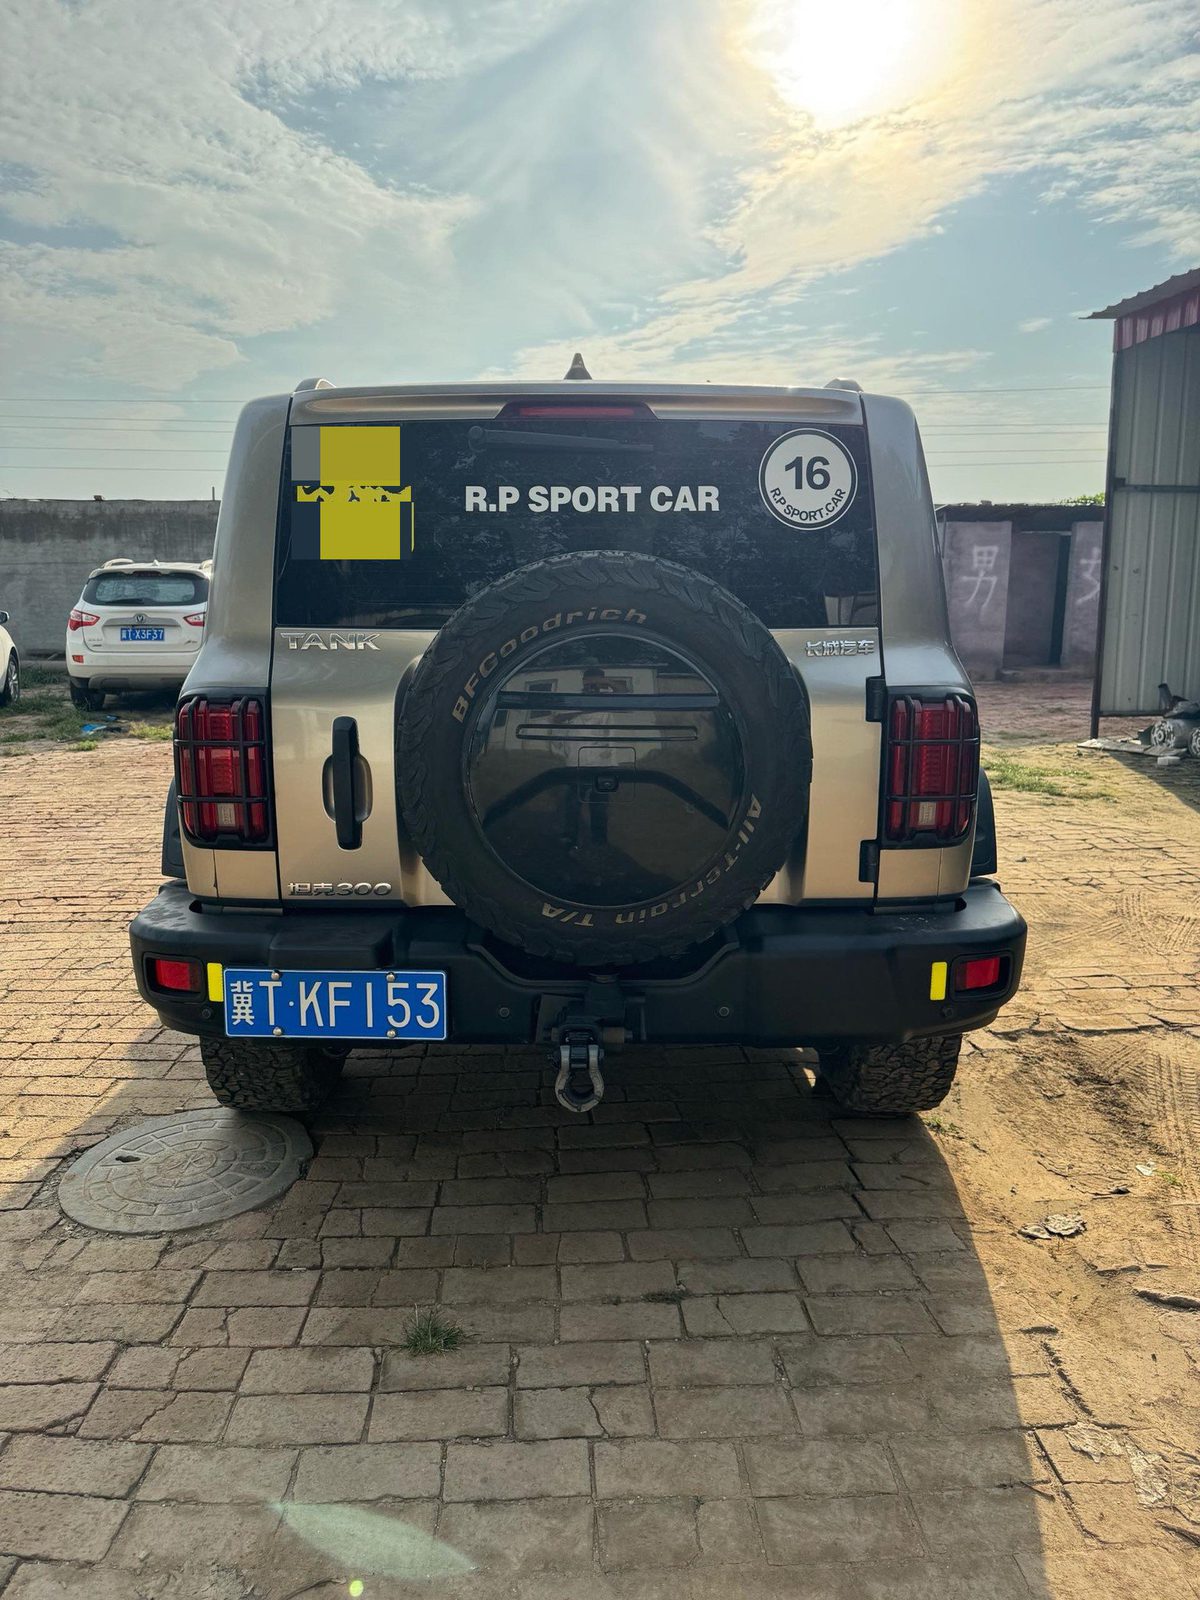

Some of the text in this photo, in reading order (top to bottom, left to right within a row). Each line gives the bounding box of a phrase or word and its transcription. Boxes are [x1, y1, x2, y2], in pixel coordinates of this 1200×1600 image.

[784, 455, 831, 491] 16
[465, 485, 720, 513] R.P SPORT CAR
[960, 544, 999, 610] 男
[280, 632, 381, 651] TANK
[805, 639, 875, 657] 长城汽车
[451, 606, 648, 724] BFGoodrich
[287, 882, 393, 897] 坦克300
[541, 902, 595, 928] T/A
